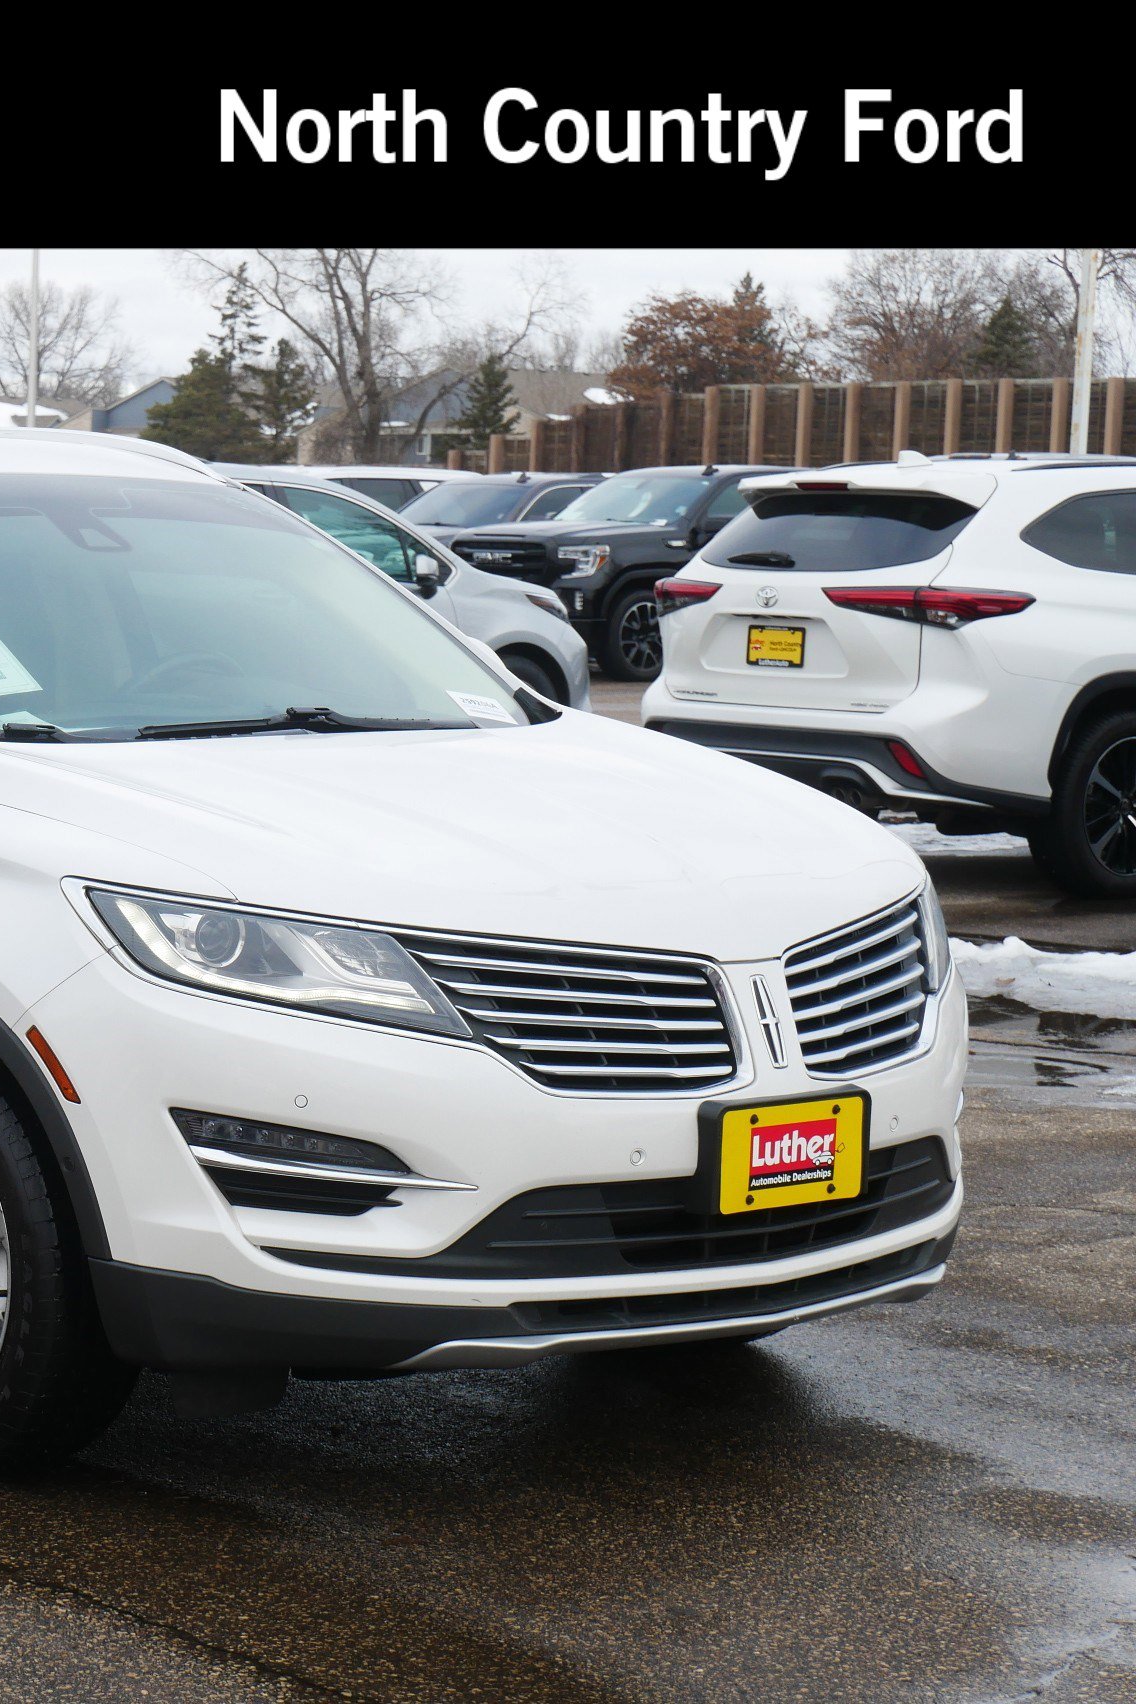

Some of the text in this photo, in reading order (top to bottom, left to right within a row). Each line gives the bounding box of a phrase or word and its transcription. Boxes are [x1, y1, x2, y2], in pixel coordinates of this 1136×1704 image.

[752, 1130, 834, 1167] Luther
[751, 1169, 831, 1187] Automobile Dealerships
